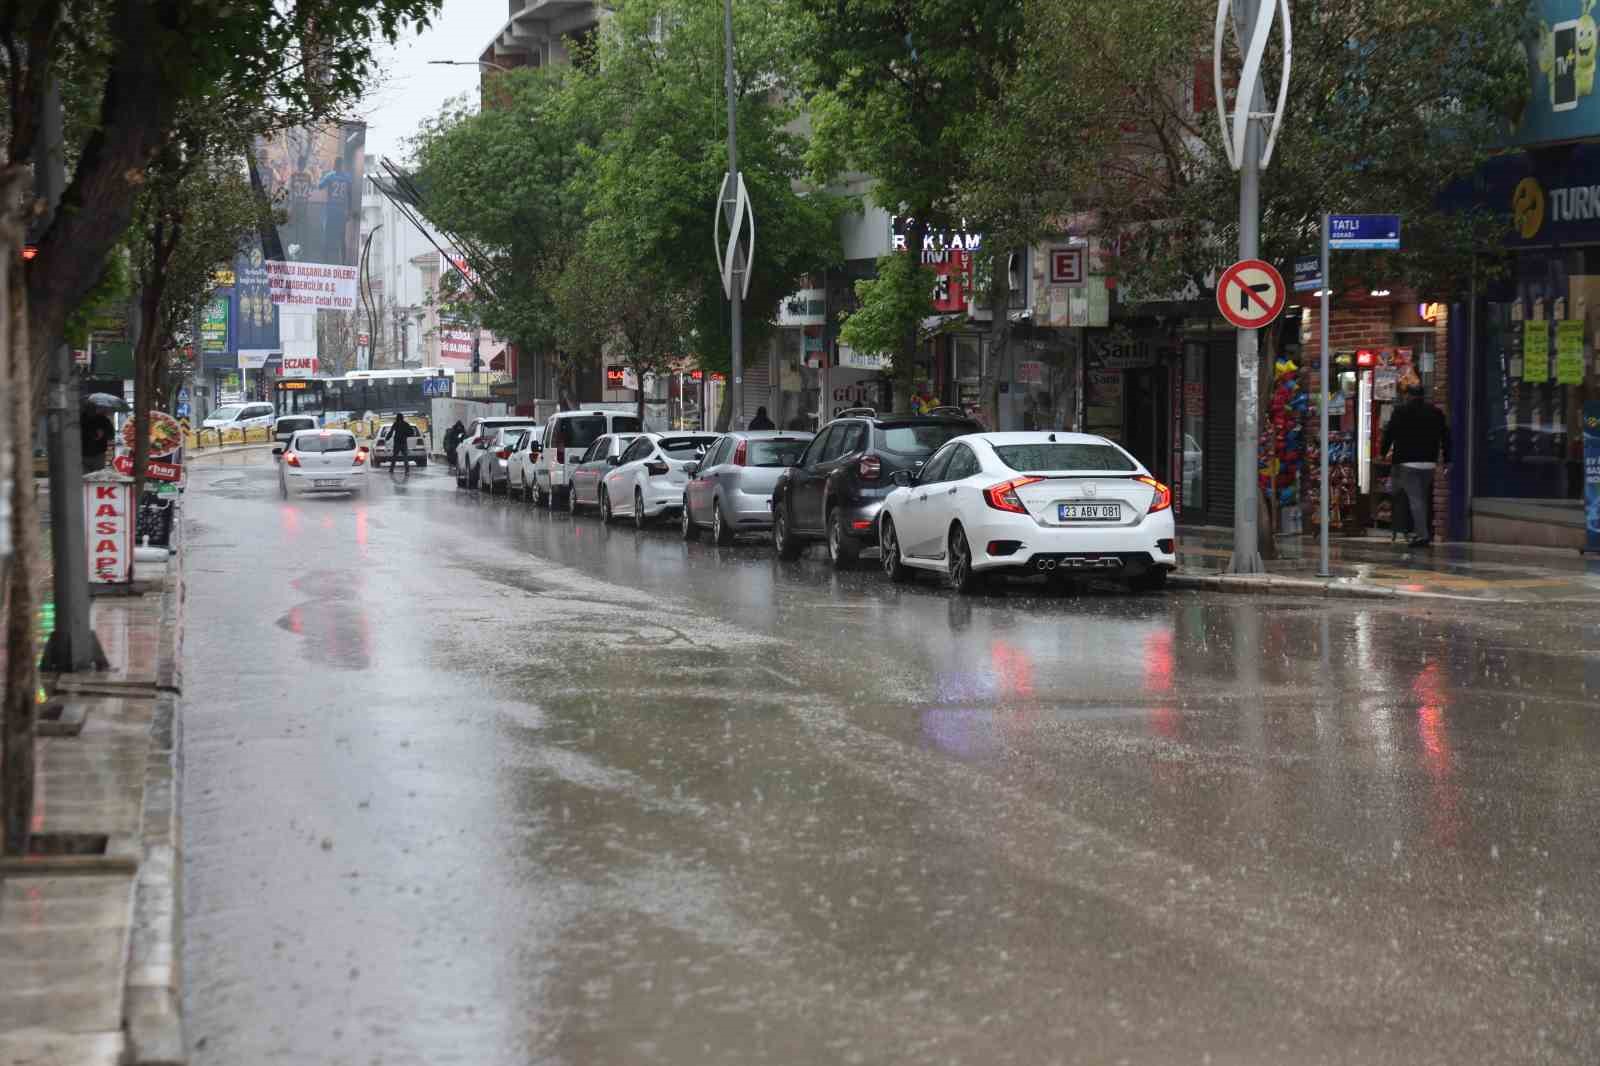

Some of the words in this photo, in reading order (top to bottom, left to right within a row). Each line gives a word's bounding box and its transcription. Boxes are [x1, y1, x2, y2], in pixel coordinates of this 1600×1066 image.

[1549, 184, 1600, 222] TURK
[1332, 219, 1360, 231] TATLI
[894, 233, 982, 249] RKLAM
[1056, 254, 1075, 278] E
[284, 358, 312, 369] ECZANE
[1065, 506, 1077, 517] 23
[1081, 506, 1098, 517] ABV
[1102, 506, 1118, 517] 081
[95, 486, 118, 572] KASAP
